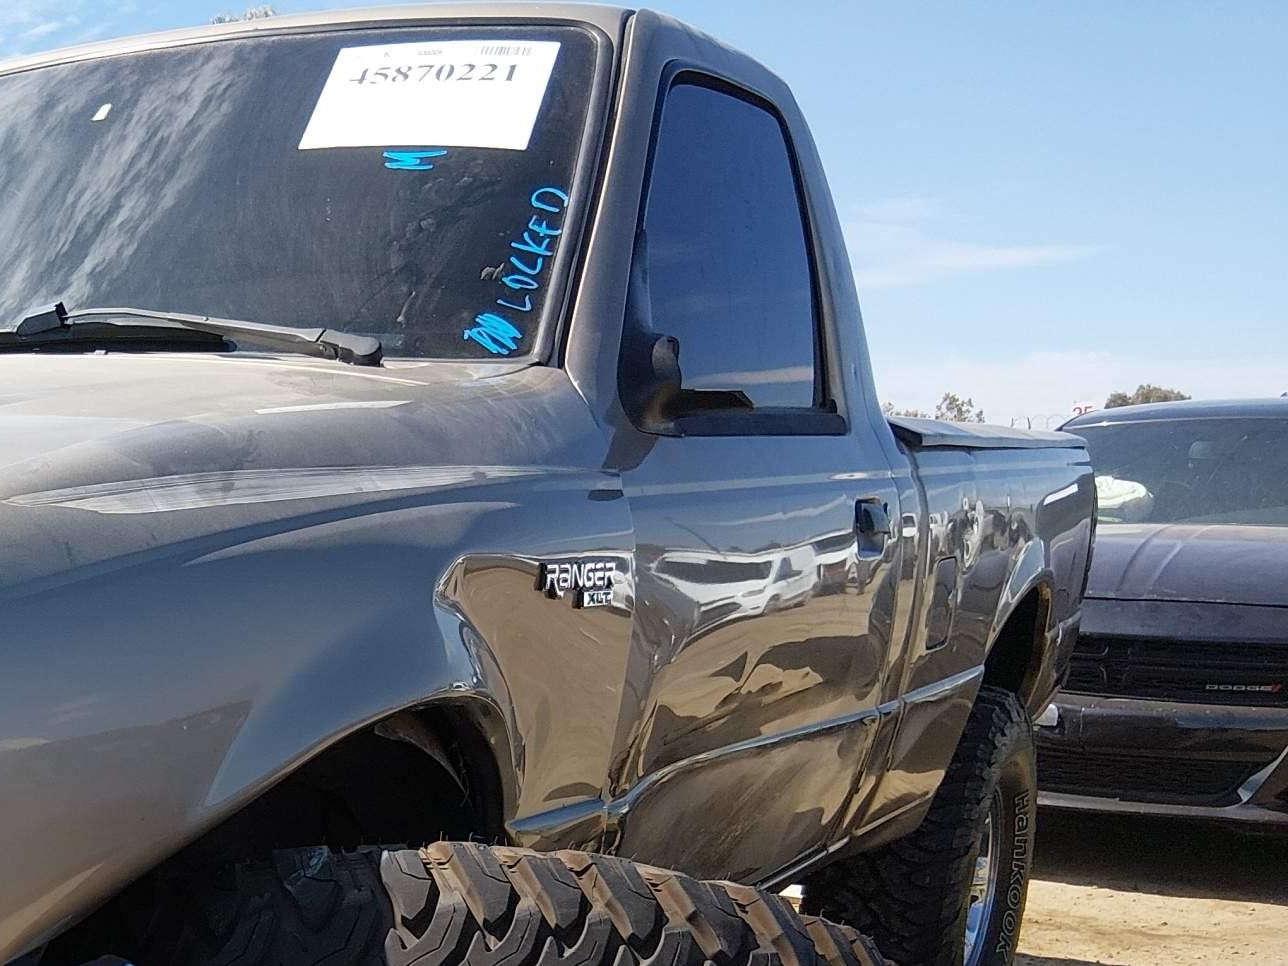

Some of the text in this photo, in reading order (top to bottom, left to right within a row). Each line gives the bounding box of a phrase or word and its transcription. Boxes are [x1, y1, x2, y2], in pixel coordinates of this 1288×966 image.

[350, 63, 518, 85] 45870221
[497, 187, 569, 312] LOCKED
[587, 592, 611, 605] XLT
[1205, 684, 1273, 692] DODGE
